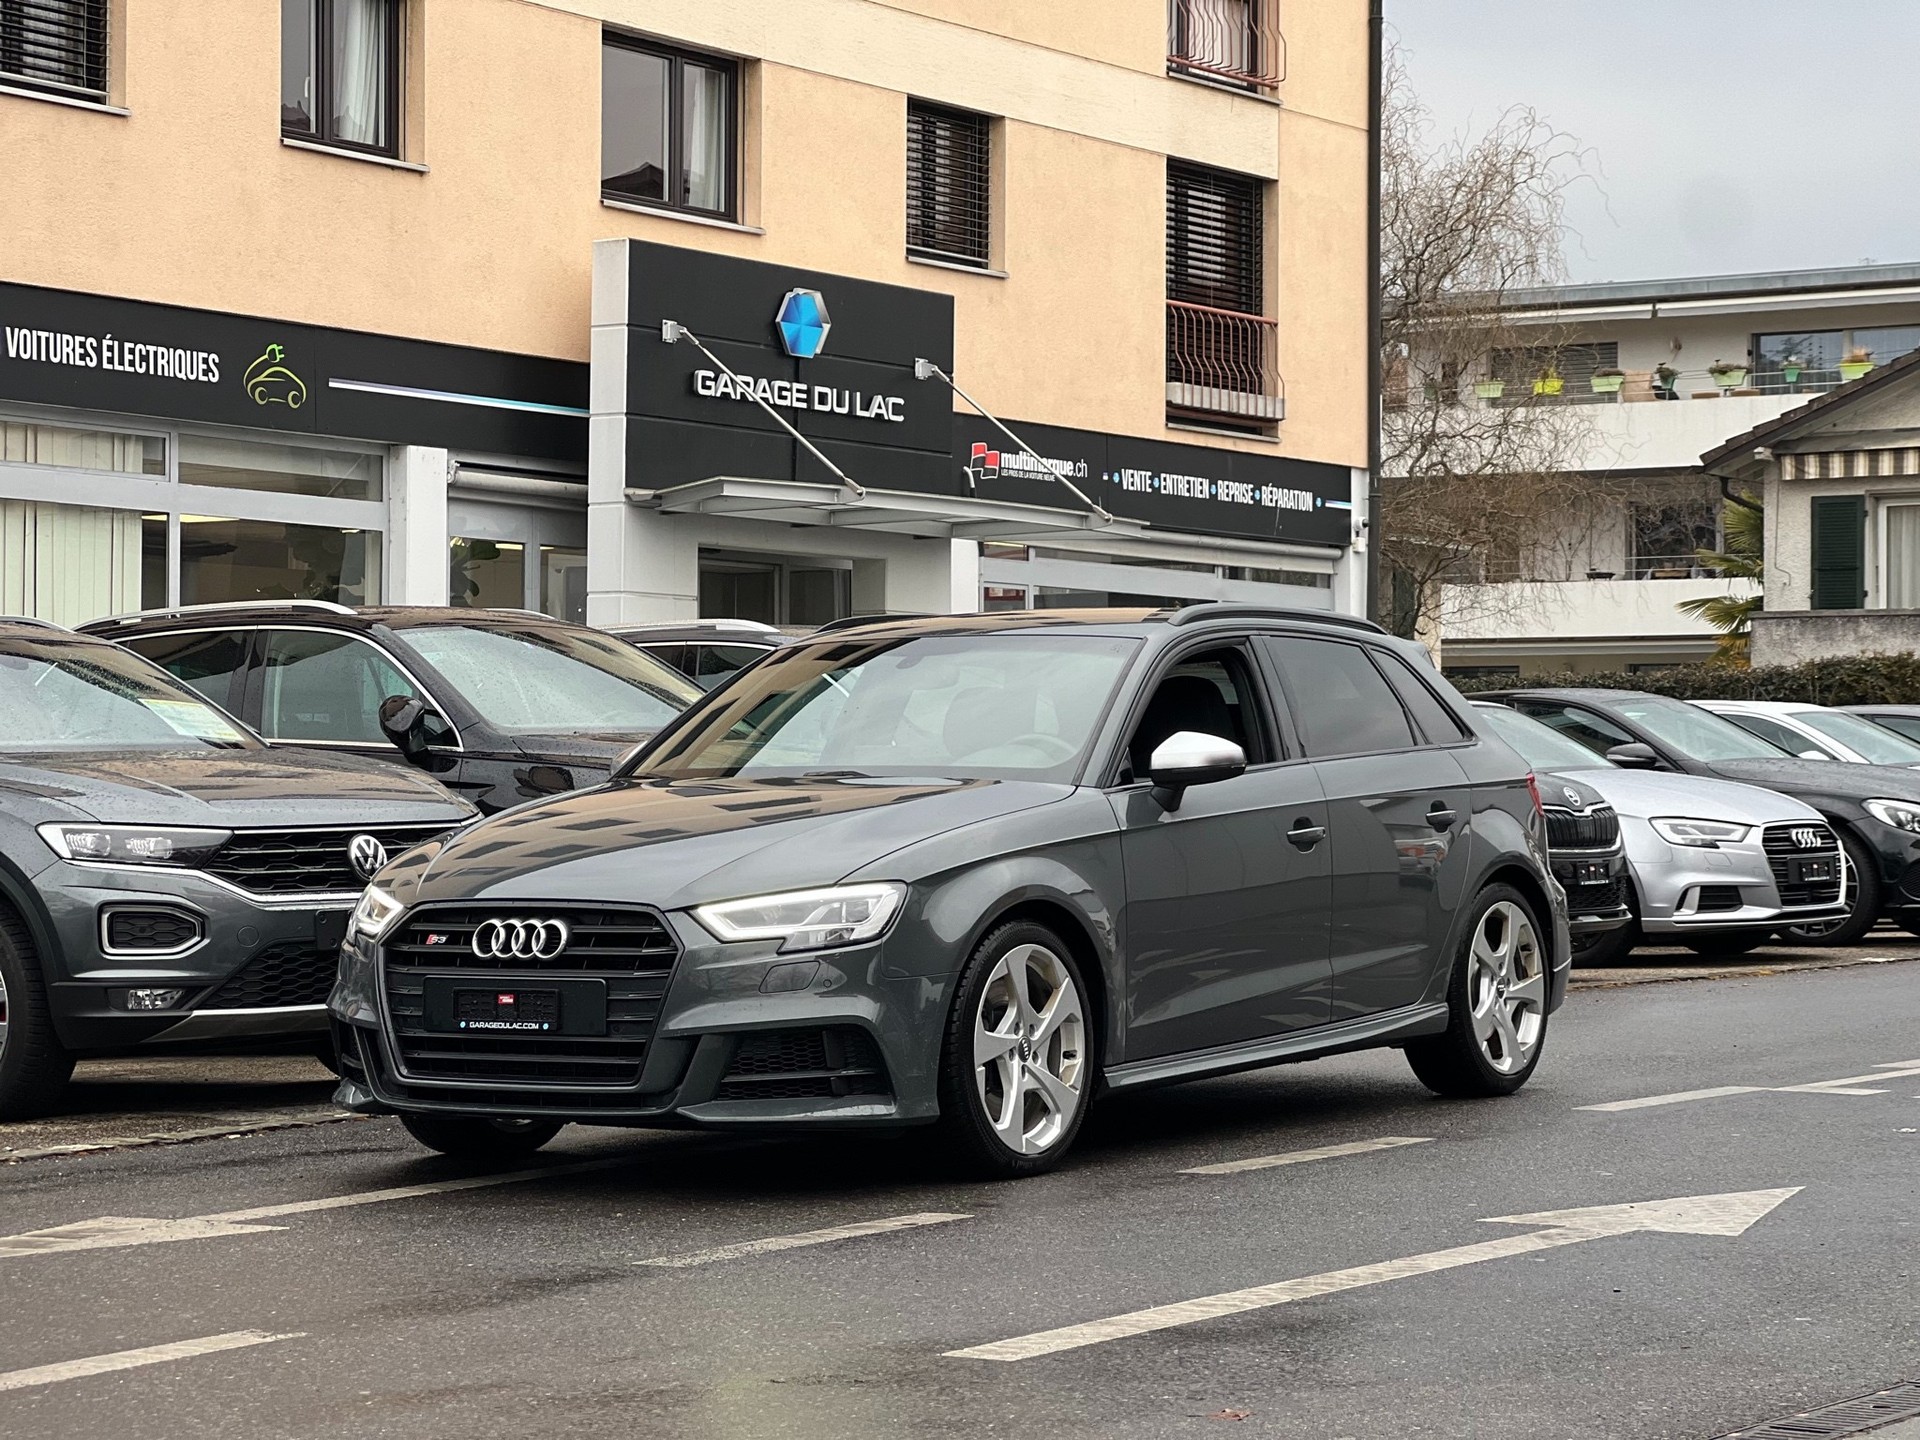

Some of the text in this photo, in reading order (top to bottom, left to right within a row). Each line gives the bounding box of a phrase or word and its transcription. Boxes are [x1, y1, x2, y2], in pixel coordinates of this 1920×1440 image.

[5, 326, 220, 383] VOITURES ÉLECTRIQUES
[694, 369, 905, 422] GARAGE DU LAC
[1121, 468, 1313, 512] VENTE ENTRETIEN REPRISE RÉPARATION
[427, 934, 447, 944] S3
